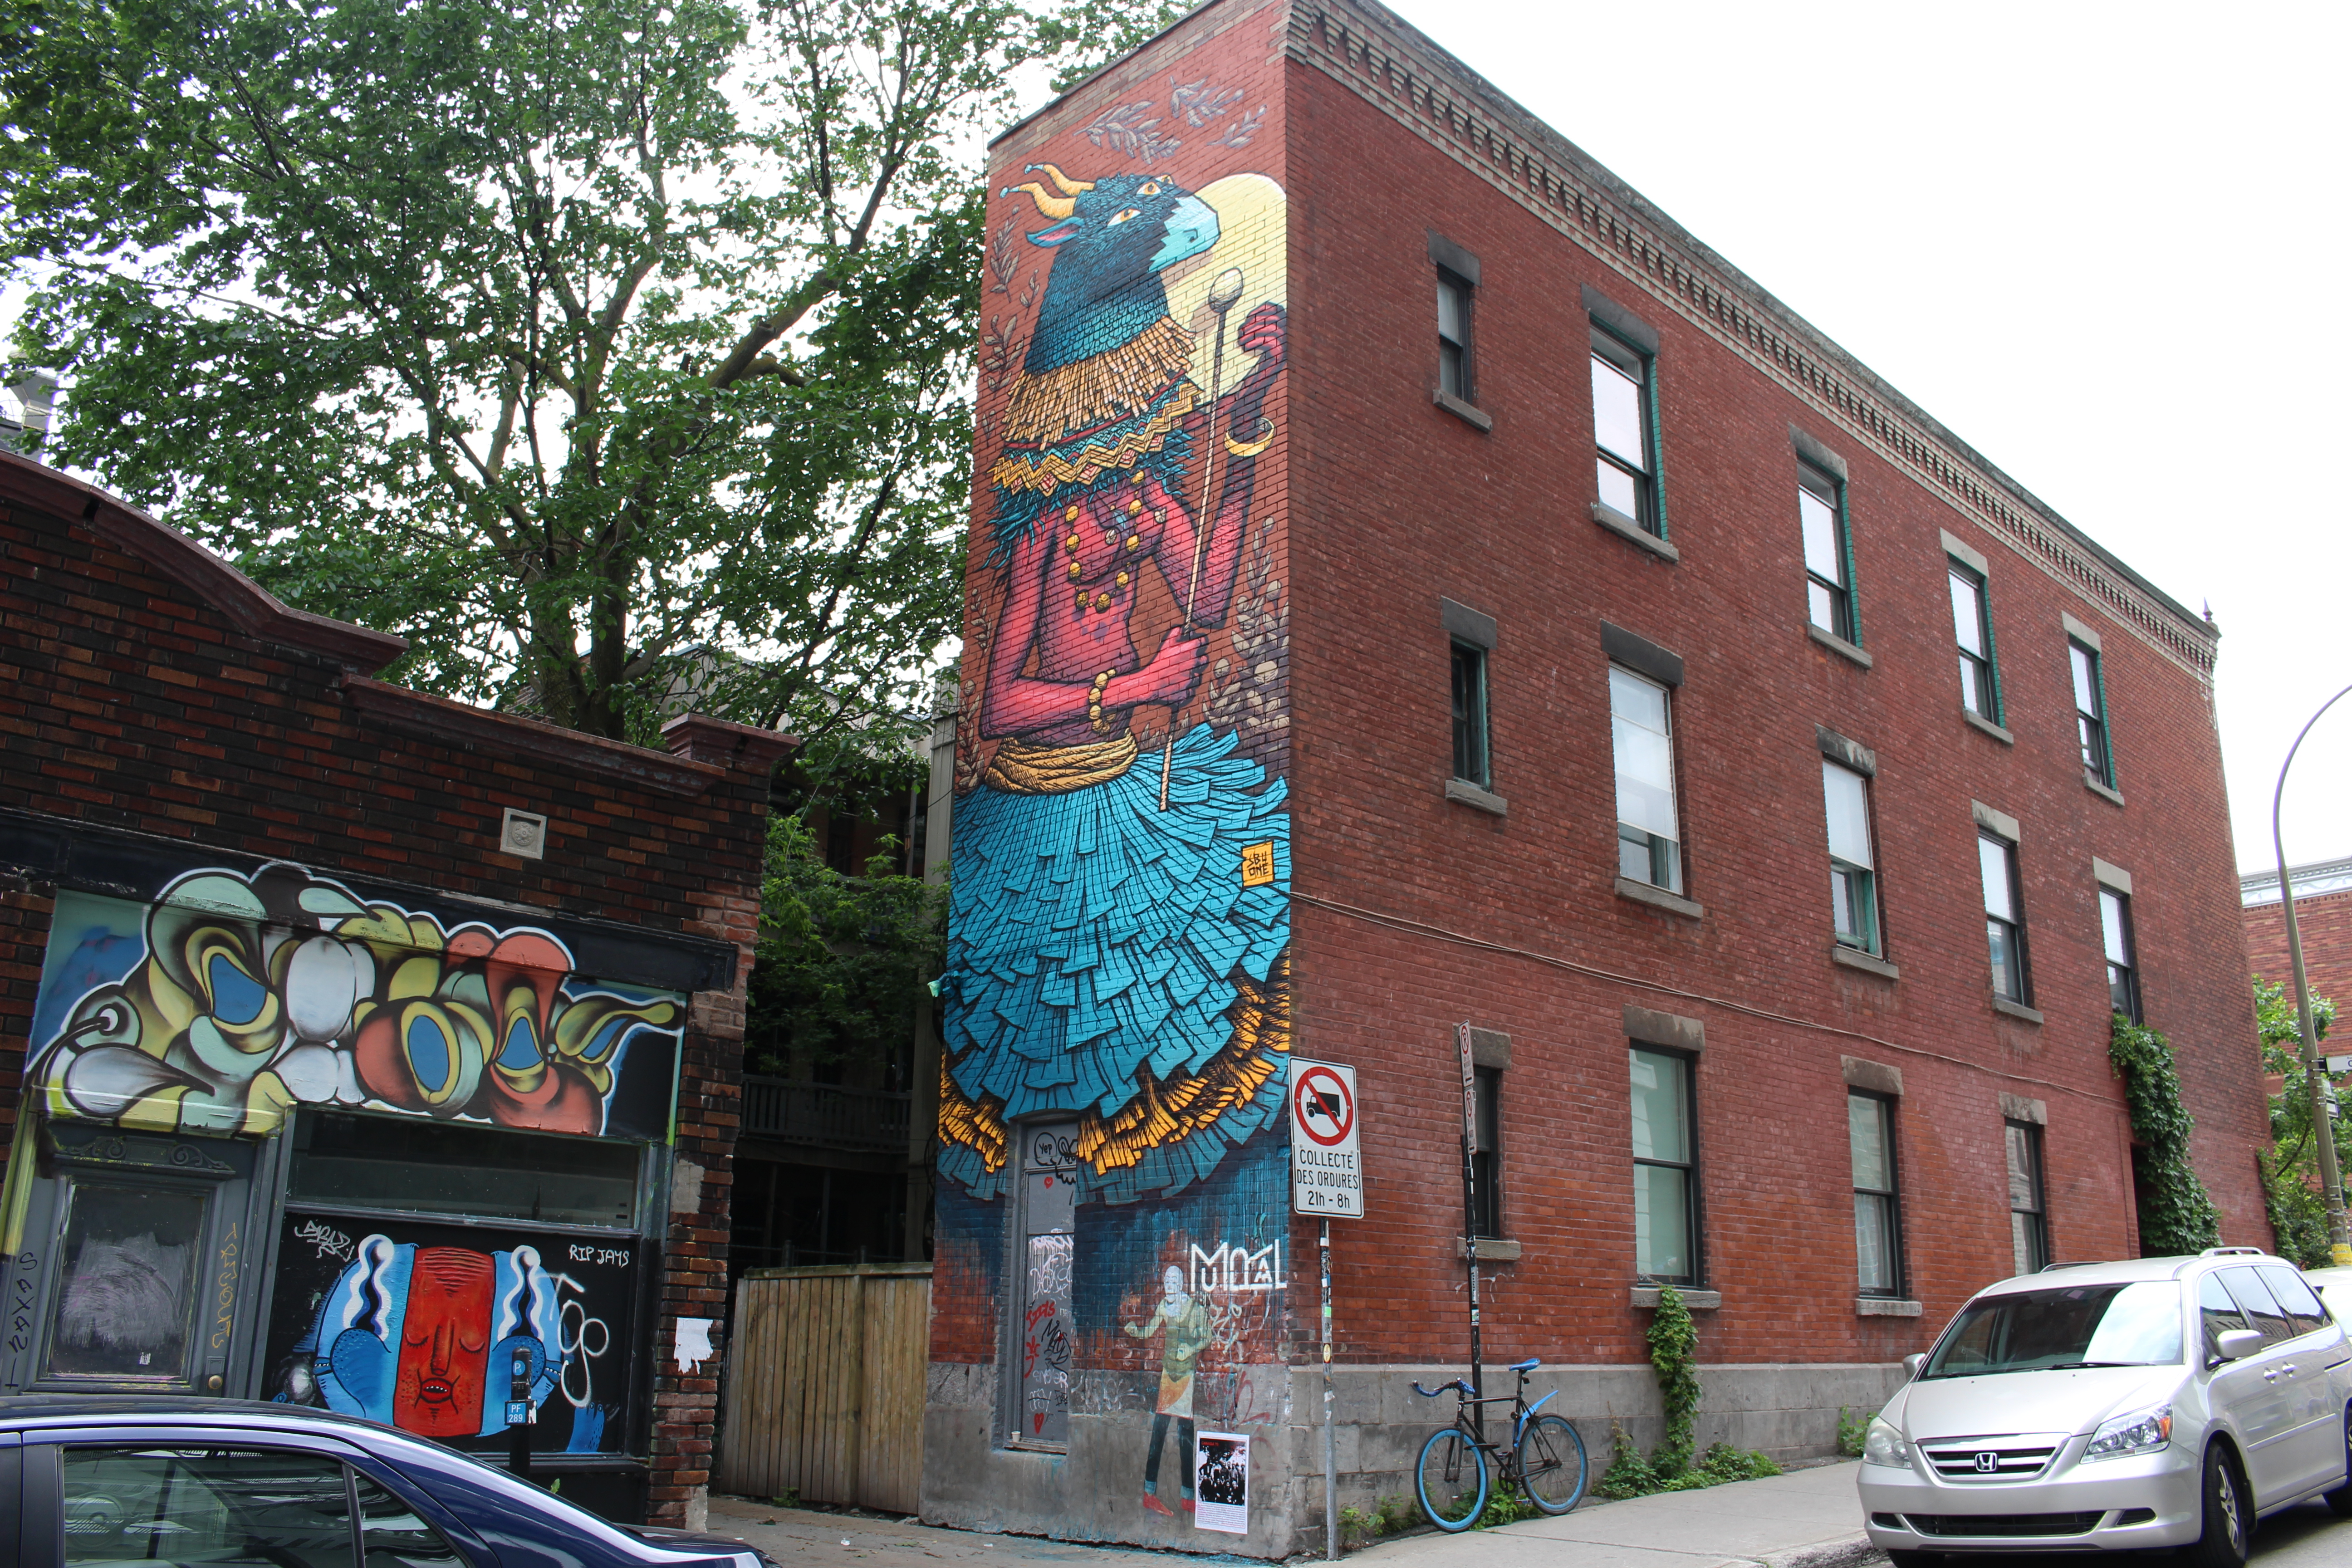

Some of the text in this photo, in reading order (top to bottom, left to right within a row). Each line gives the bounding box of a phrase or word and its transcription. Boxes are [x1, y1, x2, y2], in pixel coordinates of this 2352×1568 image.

[1248, 862, 1269, 876] ONE
[1299, 1149, 1354, 1169] COLLECTE
[1297, 1169, 1358, 1190] DES ORDURES
[1308, 1190, 1325, 1206] 21h
[1337, 1193, 1350, 1209] 8h
[569, 1244, 594, 1261] RIP
[511, 1404, 521, 1413] PF
[508, 1413, 523, 1423] 289
